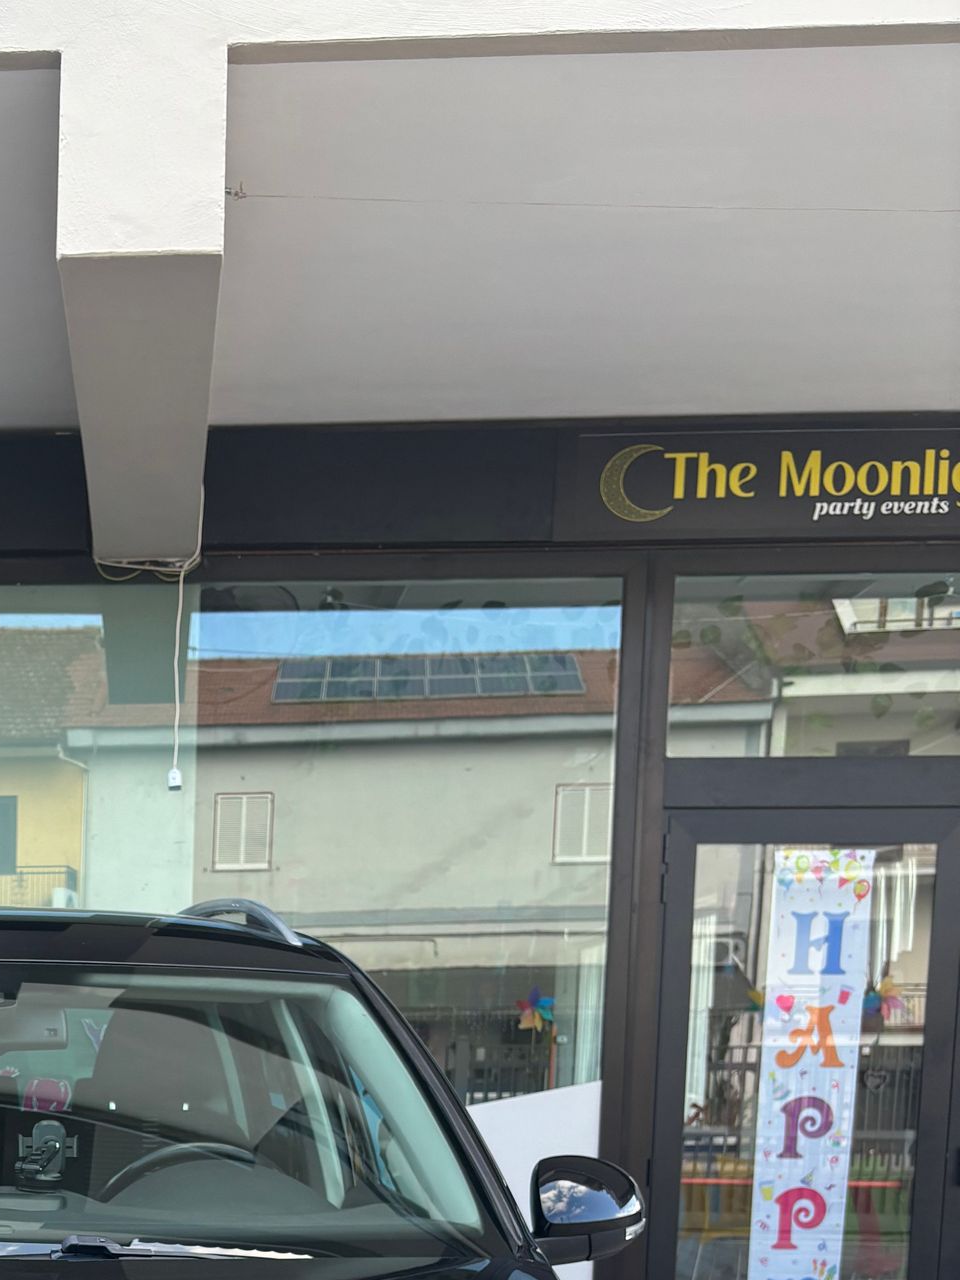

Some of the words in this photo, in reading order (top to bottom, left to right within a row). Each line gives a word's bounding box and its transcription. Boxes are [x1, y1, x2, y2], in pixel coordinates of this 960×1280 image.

[663, 452, 758, 499] The
[812, 498, 875, 521] party
[880, 497, 949, 515] events
